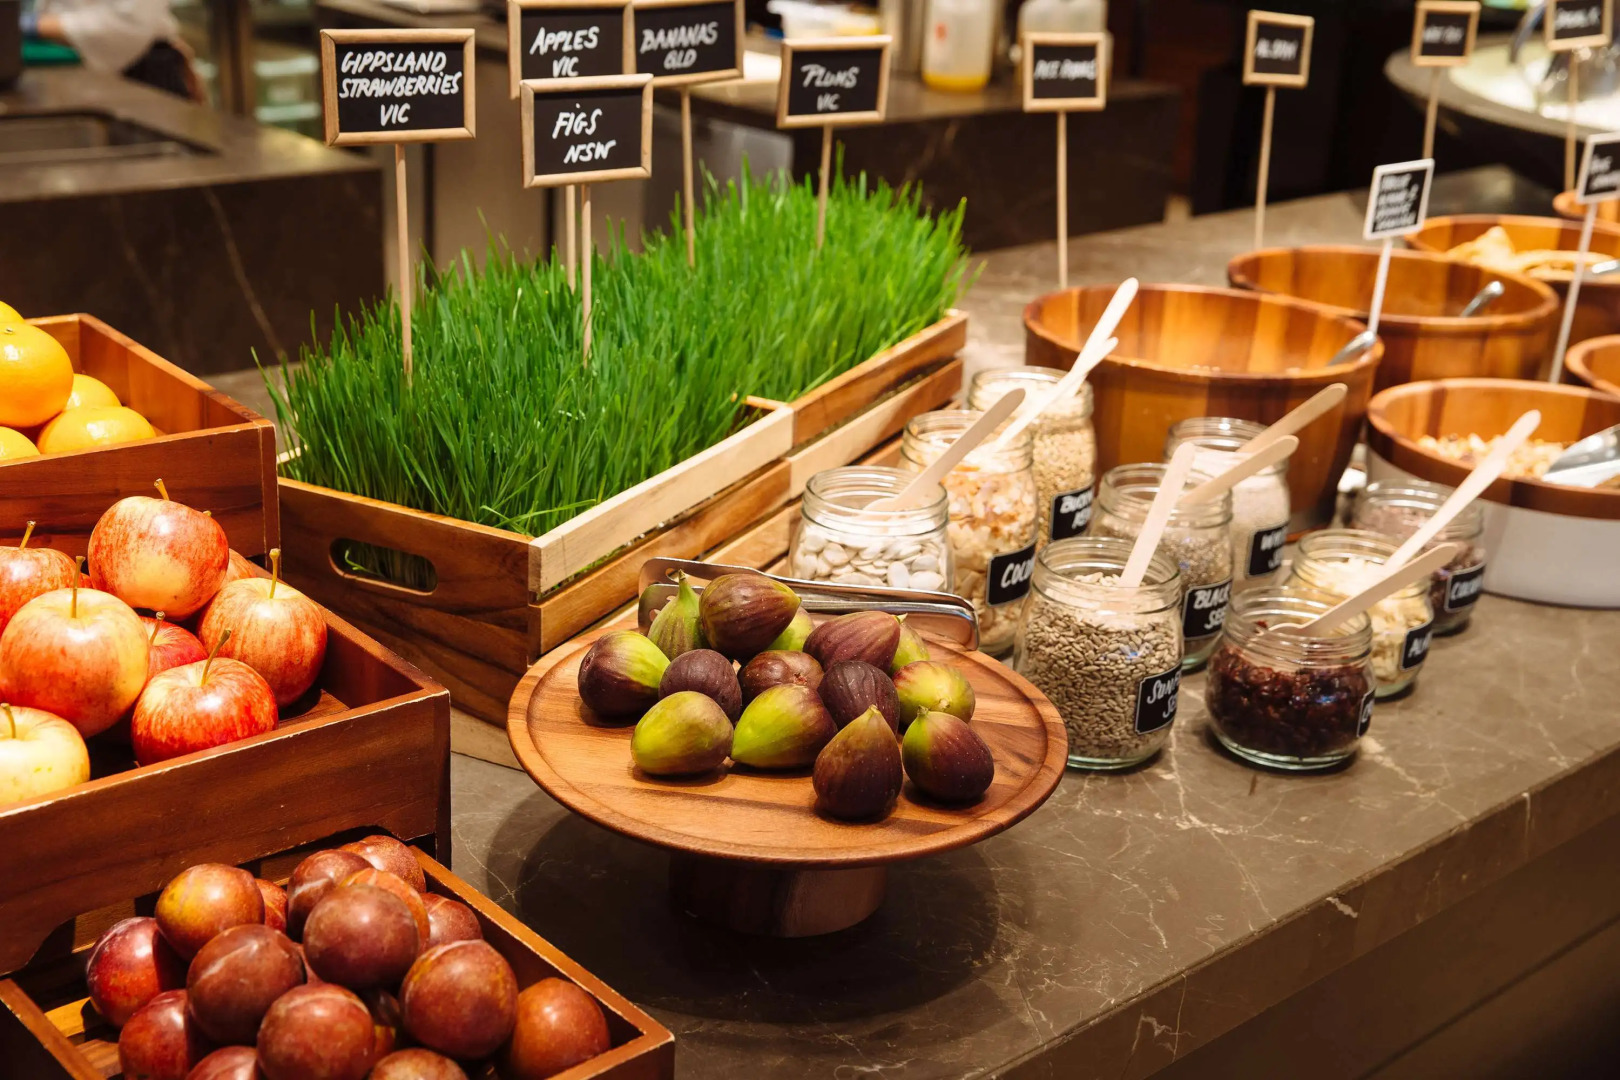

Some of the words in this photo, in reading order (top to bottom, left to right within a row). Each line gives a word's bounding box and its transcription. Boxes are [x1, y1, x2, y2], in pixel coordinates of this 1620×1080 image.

[529, 26, 600, 55] APPLES
[340, 50, 446, 75] GIPPSLAND
[552, 56, 579, 78] VIC
[380, 102, 411, 127] VIC
[562, 139, 617, 164] NSW
